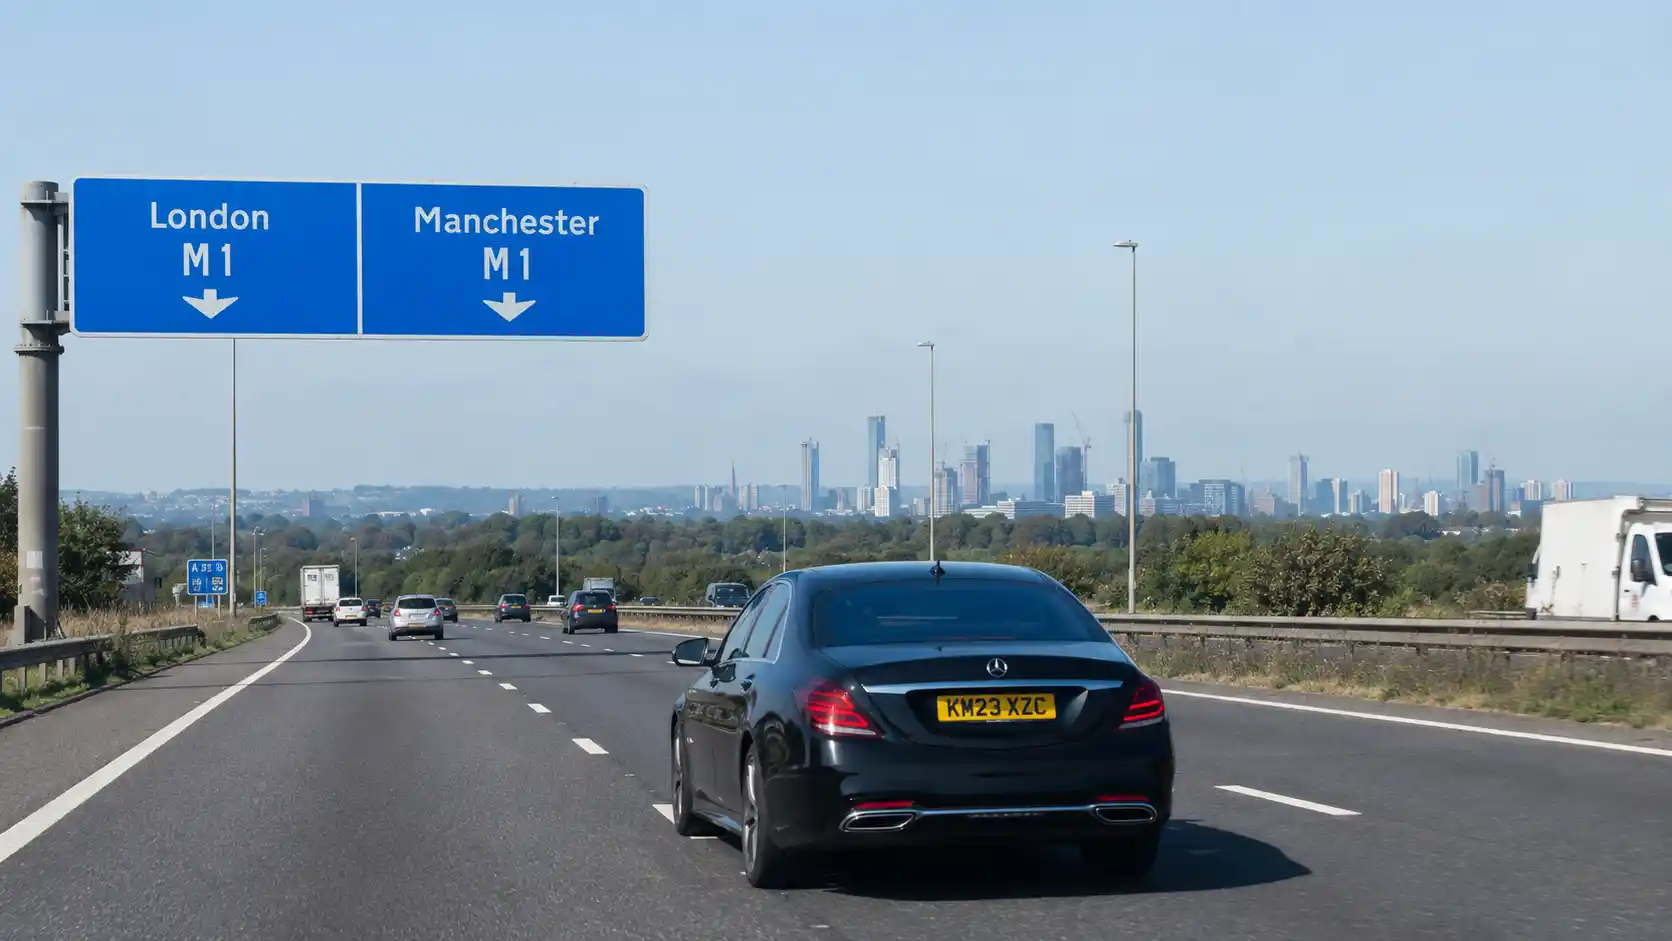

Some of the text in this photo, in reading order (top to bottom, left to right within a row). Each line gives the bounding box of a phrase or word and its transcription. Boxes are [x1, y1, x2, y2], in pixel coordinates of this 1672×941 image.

[150, 201, 269, 230] London
[414, 206, 600, 236] Manchester
[947, 696, 1047, 718] KM23 XZC
